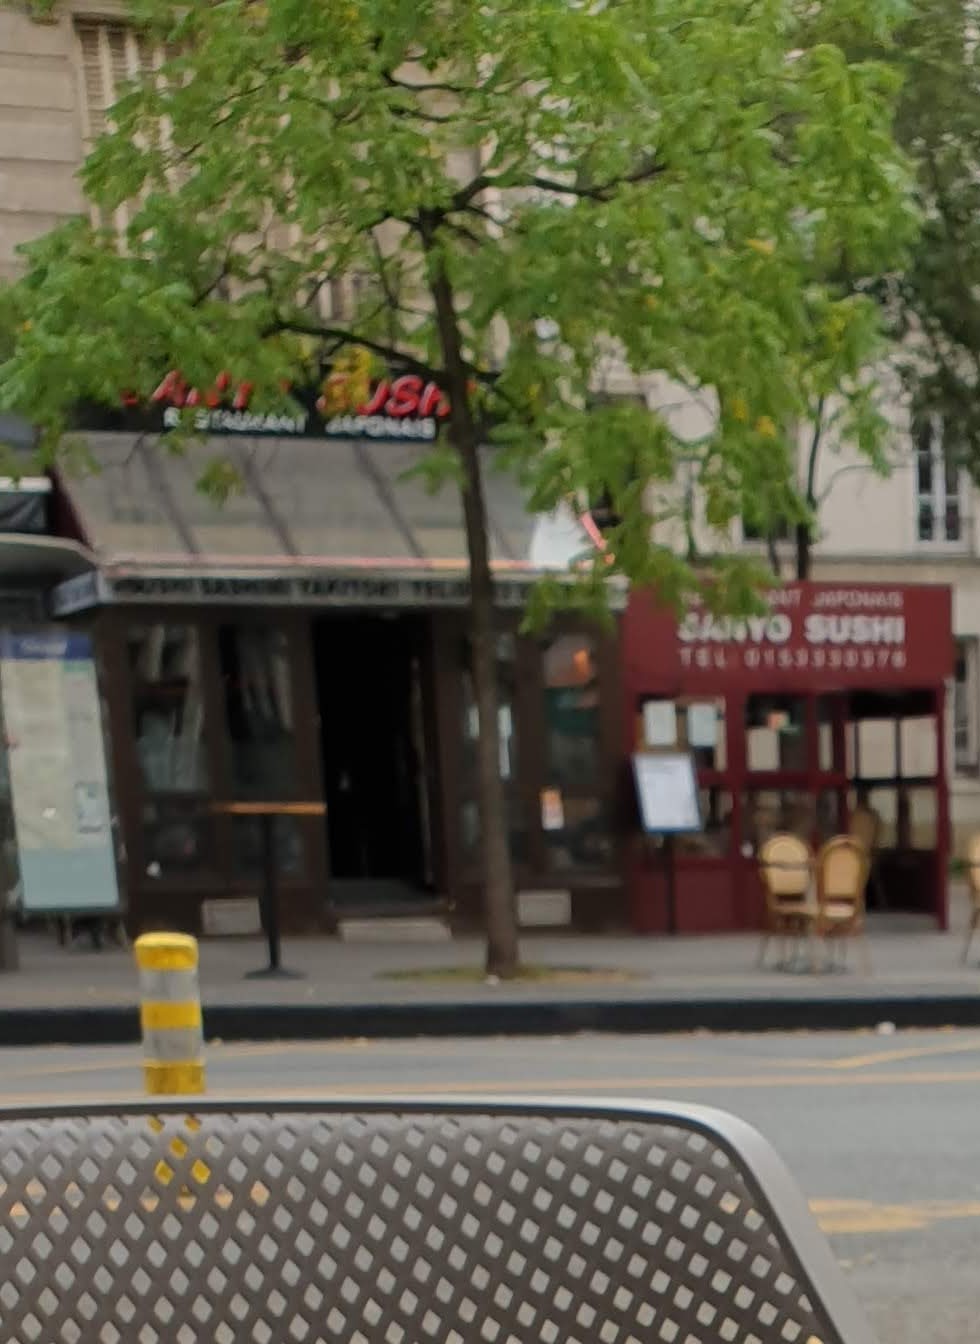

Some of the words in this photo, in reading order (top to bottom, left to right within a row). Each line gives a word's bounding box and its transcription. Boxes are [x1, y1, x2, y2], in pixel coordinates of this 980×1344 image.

[163, 406, 309, 434] RSTAURANT
[803, 613, 906, 645] SUSHI
[679, 647, 729, 669] TEL
